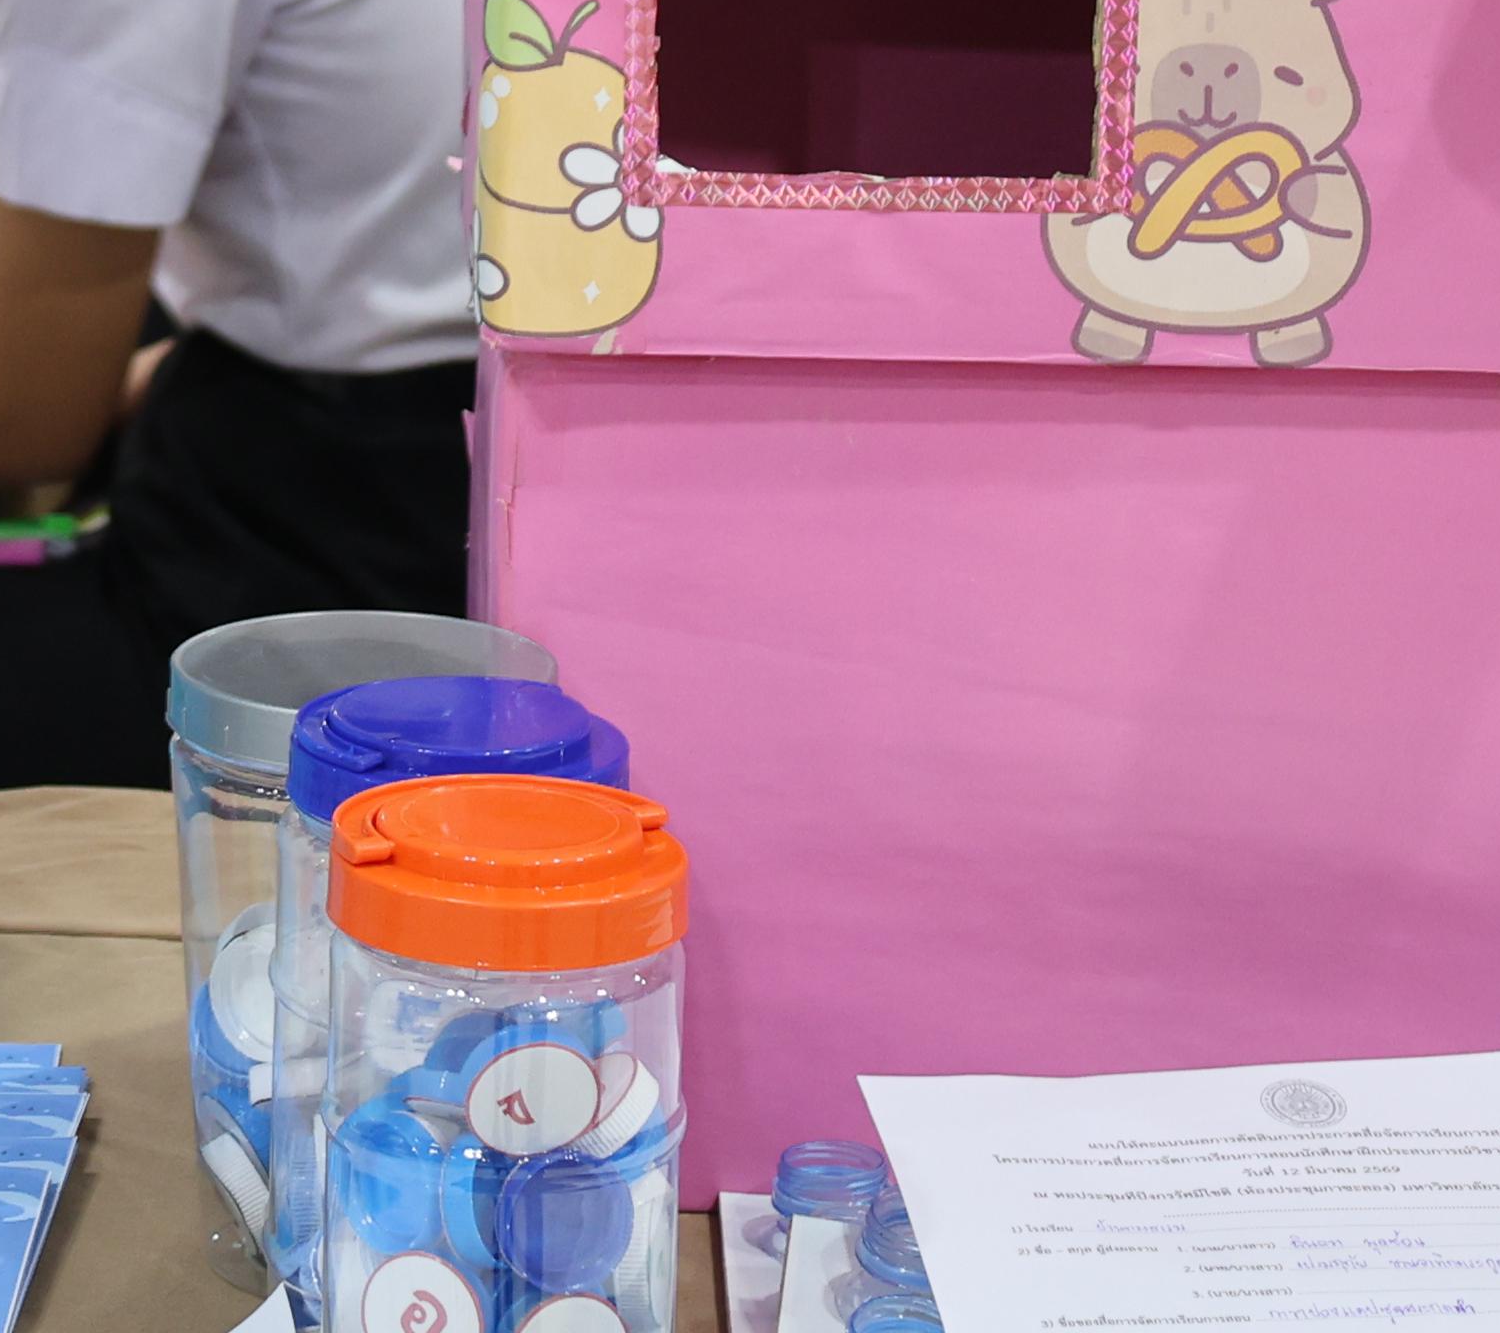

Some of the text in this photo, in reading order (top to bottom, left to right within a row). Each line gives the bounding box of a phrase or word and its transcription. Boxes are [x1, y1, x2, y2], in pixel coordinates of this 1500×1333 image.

[1305, 1164, 1357, 1176] มีนาคม
[1362, 1165, 1402, 1175] 2569
